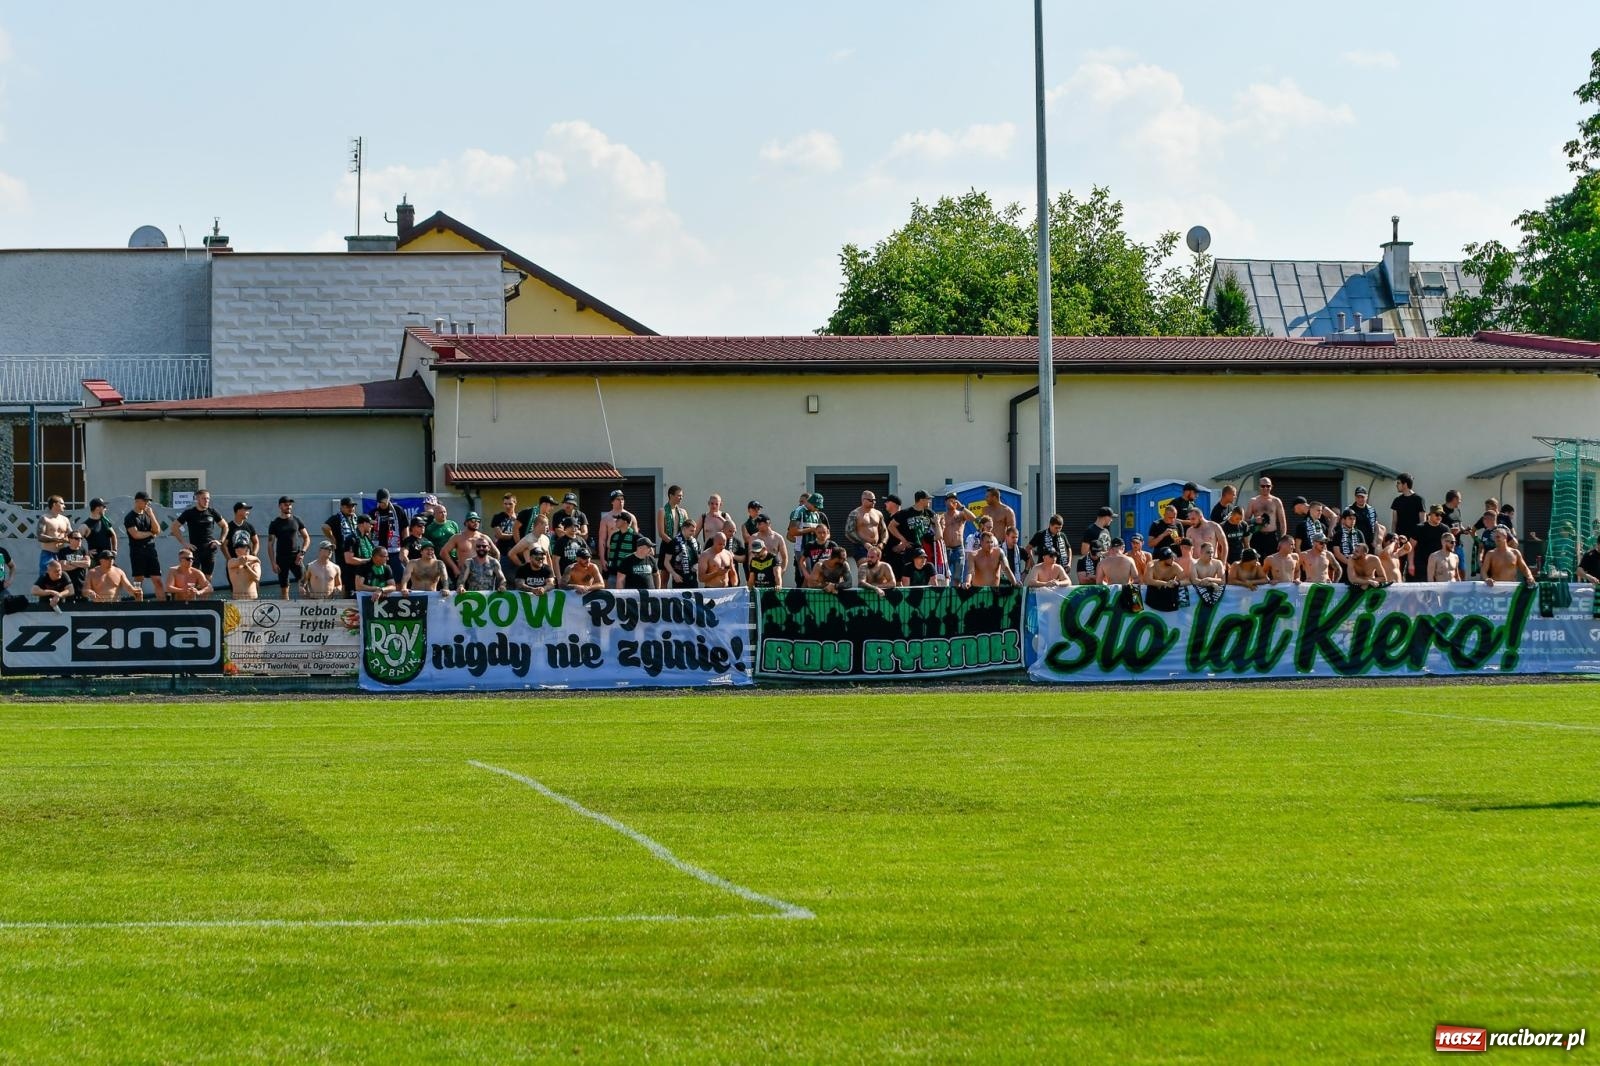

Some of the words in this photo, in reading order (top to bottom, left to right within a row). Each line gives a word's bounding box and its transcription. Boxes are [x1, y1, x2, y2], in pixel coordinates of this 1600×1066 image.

[300, 606, 337, 616] Kebab
[300, 619, 335, 631] Frytki
[454, 591, 566, 628] ROW
[583, 590, 719, 631] Rybnik
[1045, 585, 1180, 673] Sto
[1186, 589, 1294, 674] lat
[1294, 582, 1537, 674] Kiero!
[242, 630, 262, 644] The
[264, 630, 290, 644] Best
[300, 634, 329, 645] Lody
[370, 622, 420, 667] ROW
[432, 632, 531, 677] nigdy
[545, 633, 604, 668] nie
[617, 631, 746, 677] zginie!
[763, 638, 853, 673] ROW
[862, 629, 1022, 673] RYBNIK
